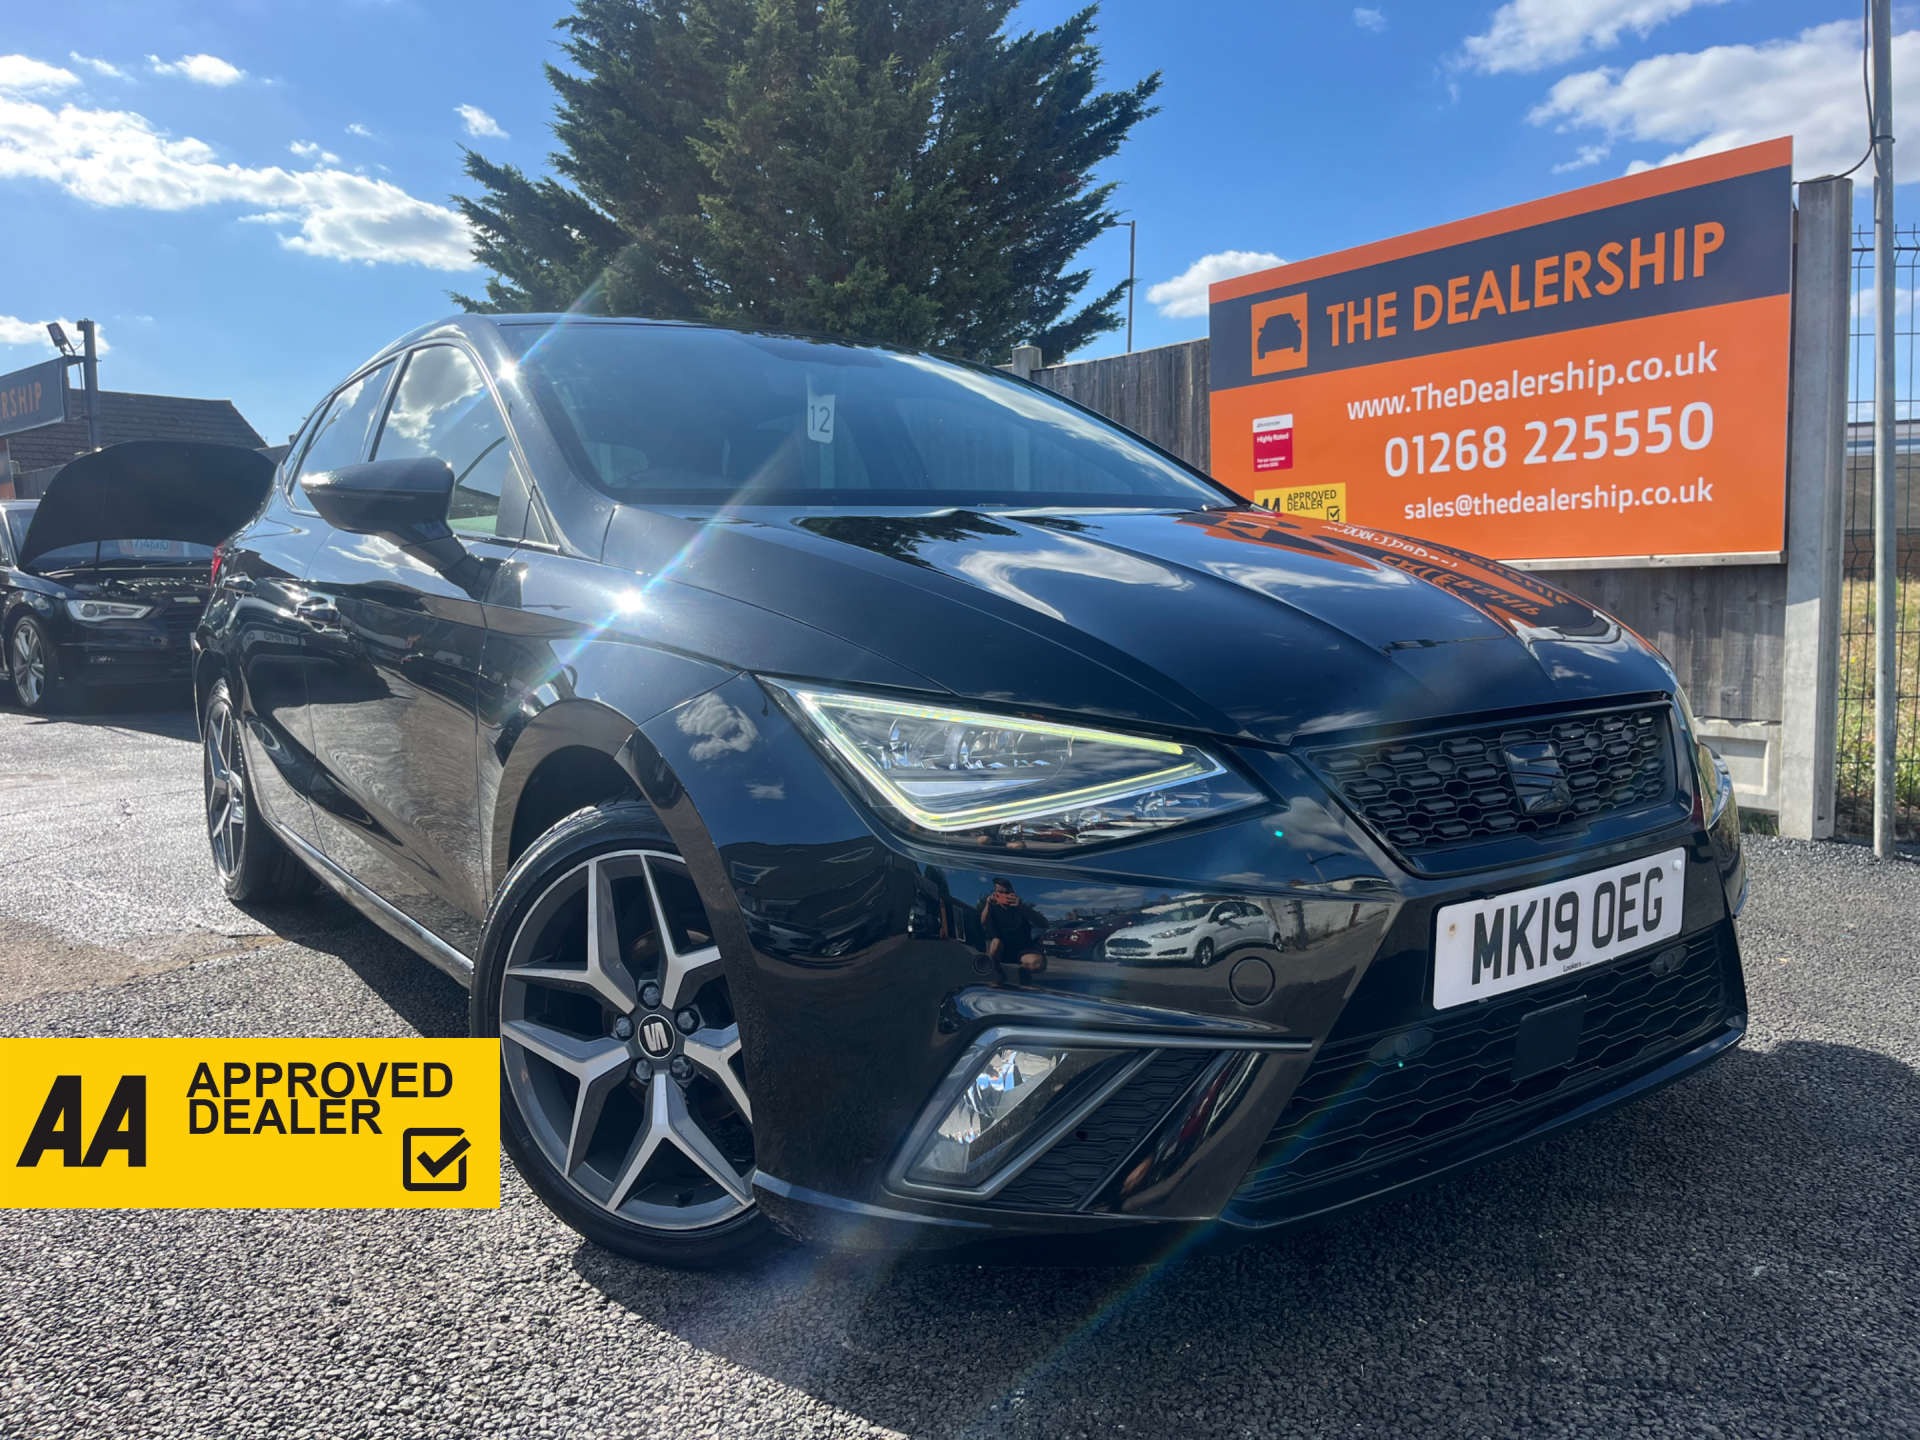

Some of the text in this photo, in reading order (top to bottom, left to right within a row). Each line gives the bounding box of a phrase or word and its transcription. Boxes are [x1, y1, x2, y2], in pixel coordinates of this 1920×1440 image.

[1326, 221, 1725, 347] THE DEALERSHIP
[1347, 340, 1718, 420] www.TheDealership.co.uk
[811, 405, 831, 433] 12
[1385, 401, 1714, 478] 01268 225550
[1287, 490, 1337, 501] APPROVED
[1287, 501, 1323, 512] DEALER
[1404, 476, 1713, 520] sales@thedealership.co.uk
[1472, 866, 1664, 986] MK19 OEG
